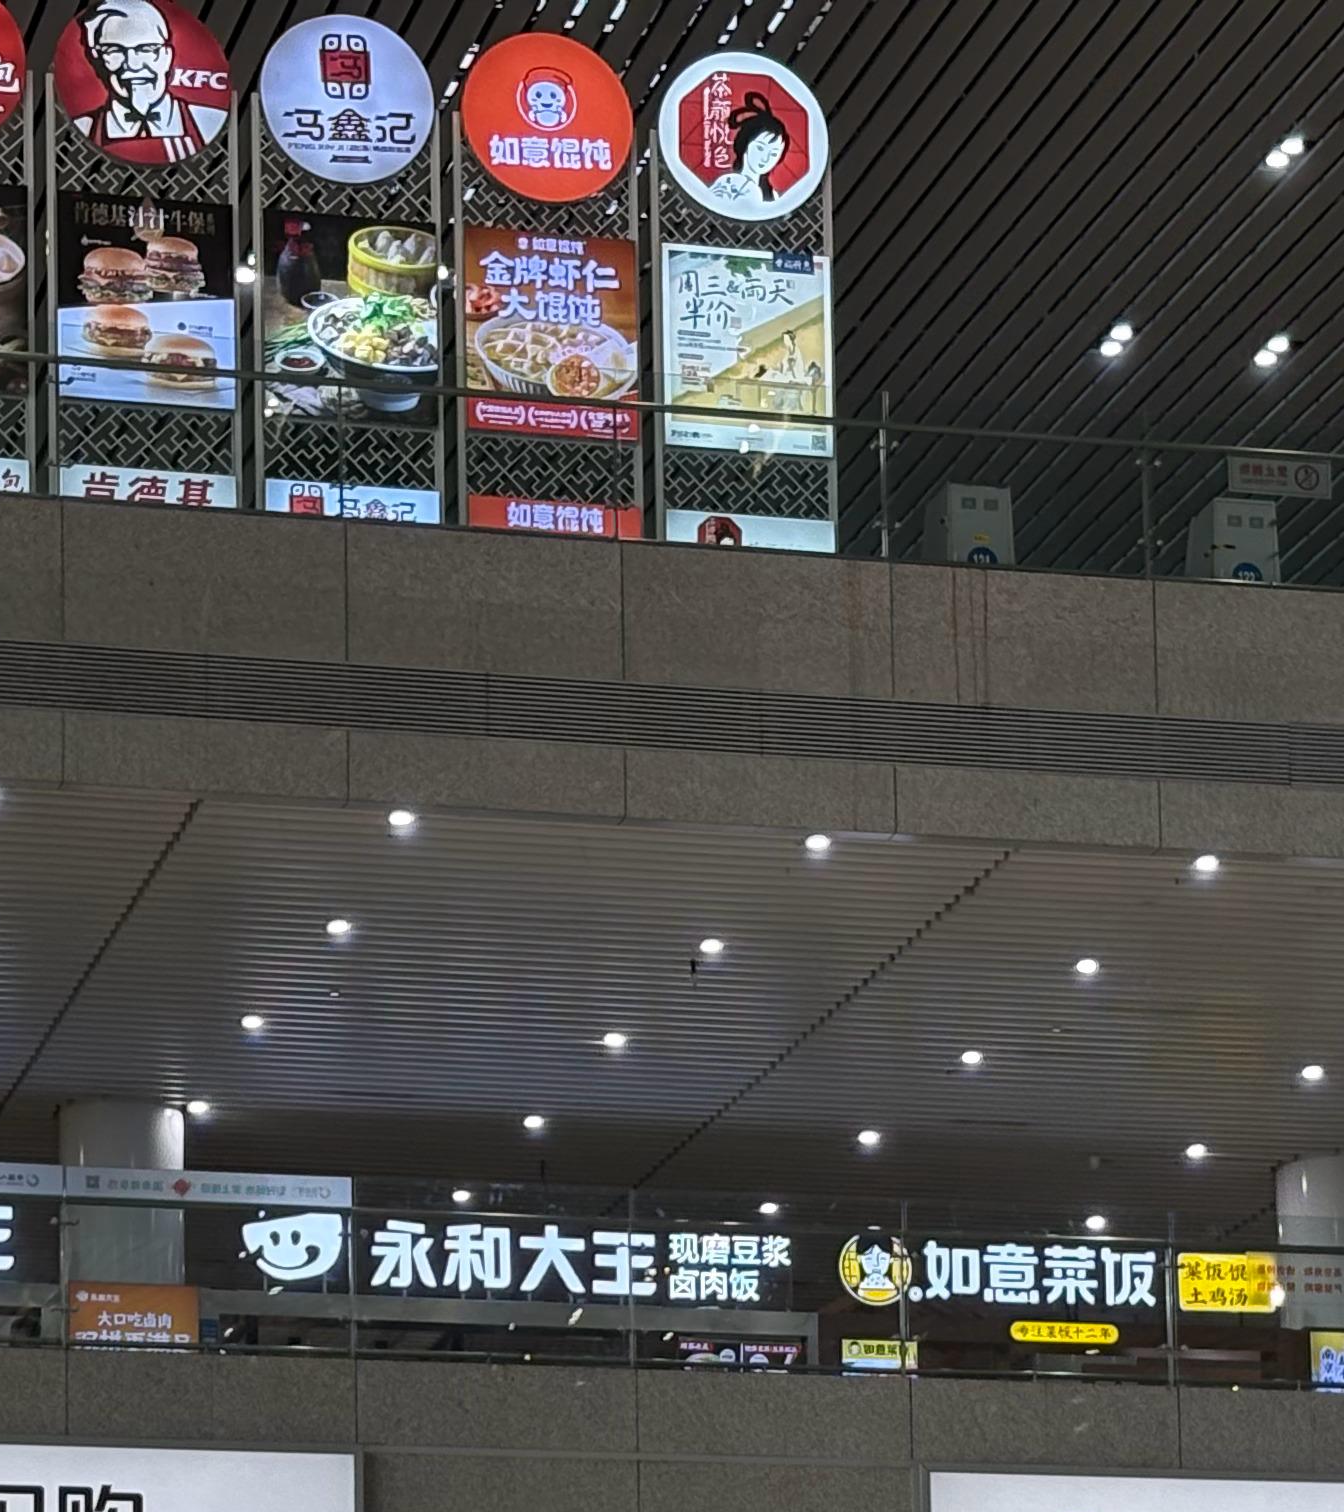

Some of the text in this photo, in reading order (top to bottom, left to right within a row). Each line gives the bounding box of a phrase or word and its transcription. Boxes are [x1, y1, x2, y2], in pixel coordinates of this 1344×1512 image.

[170, 67, 229, 90] KFC
[490, 134, 613, 170] 如意馄饨
[480, 251, 620, 292] 金牌虾仁
[498, 288, 601, 325] 大馄饨
[680, 299, 735, 329] 半价
[83, 472, 215, 508] 肯德基
[507, 502, 603, 534] 如意馄饨
[371, 1220, 656, 1297] 永和大王
[669, 1234, 791, 1269] 现磨豆浆
[669, 1268, 760, 1302] 卤肉饭
[924, 1239, 1157, 1307] 如意菜饭
[97, 1310, 173, 1329] 大口吃卤肉
